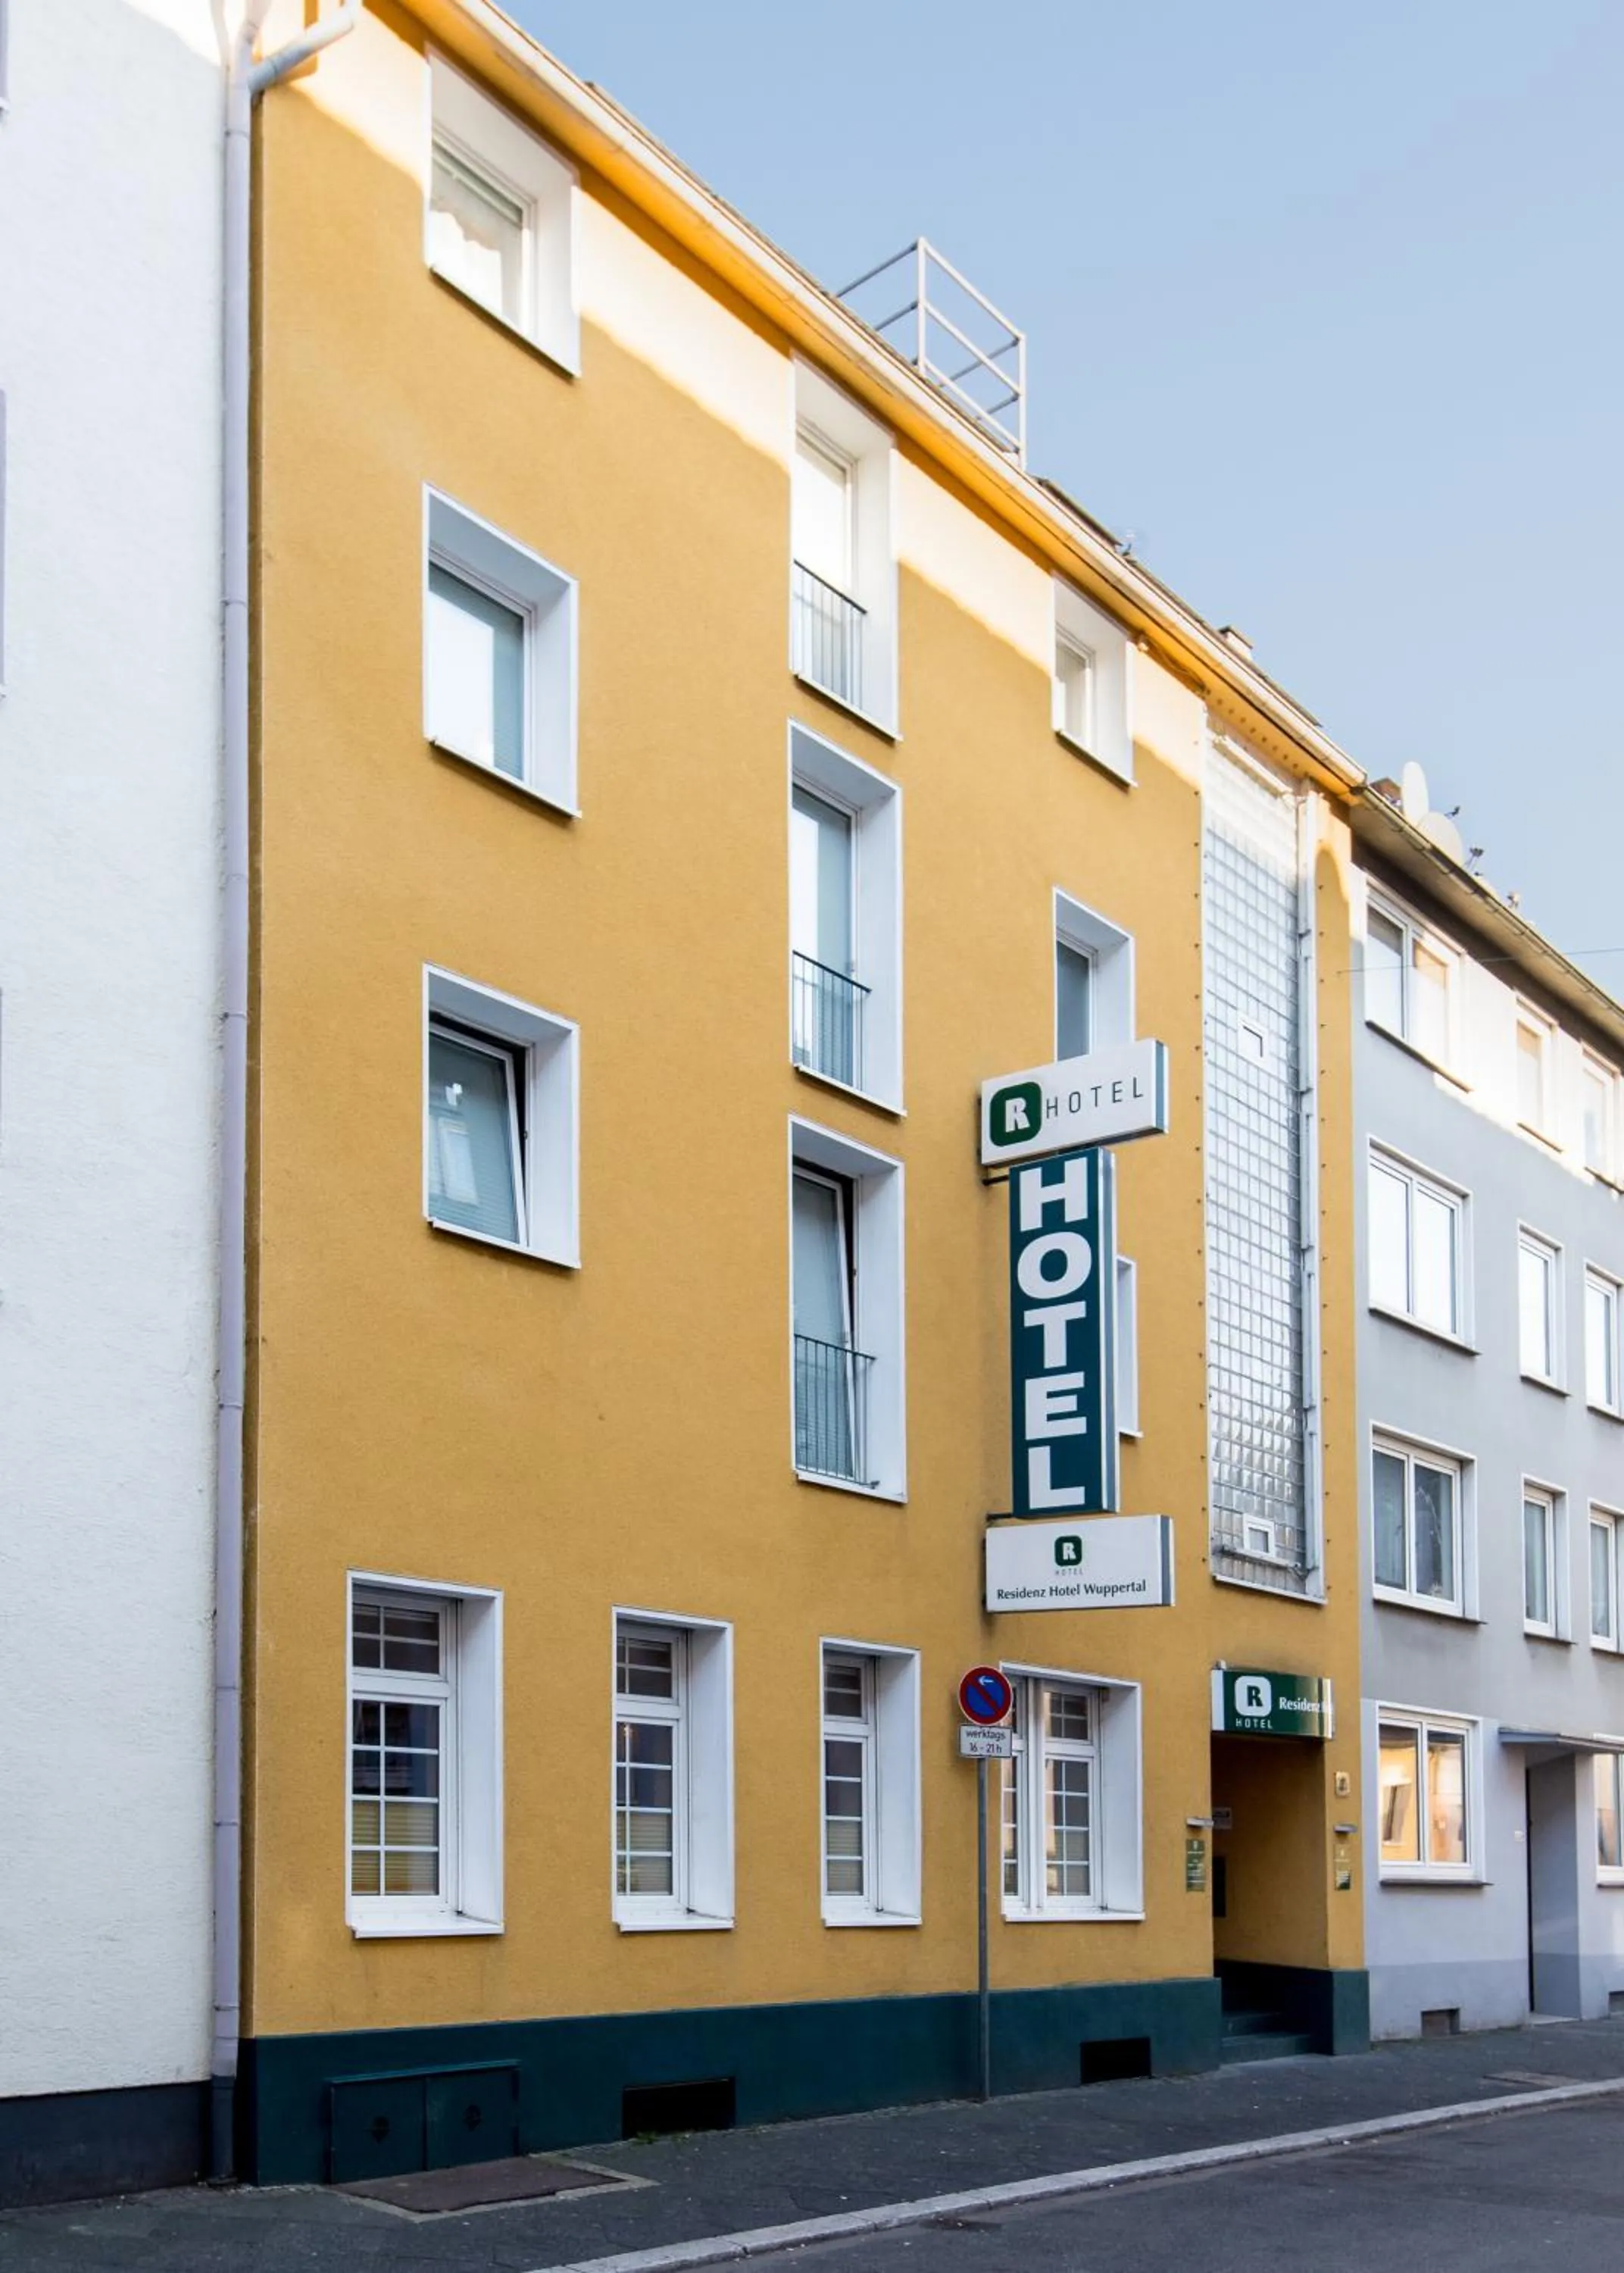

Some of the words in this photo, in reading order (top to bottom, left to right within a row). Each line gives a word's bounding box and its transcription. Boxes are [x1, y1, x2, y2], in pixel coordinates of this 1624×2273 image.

[1004, 1097, 1031, 1133] R
[1045, 1077, 1144, 1119] HOTEL
[1017, 1157, 1092, 1509] HOTEL
[1055, 1568, 1084, 1577] HOTEL
[997, 1587, 1046, 1599] Residenz
[1049, 1584, 1081, 1597] Hotel
[1084, 1579, 1146, 1597] Wuppertal
[1235, 1718, 1273, 1729] HOTEL
[966, 1730, 1006, 1742] werktags
[970, 1742, 978, 1752] 16
